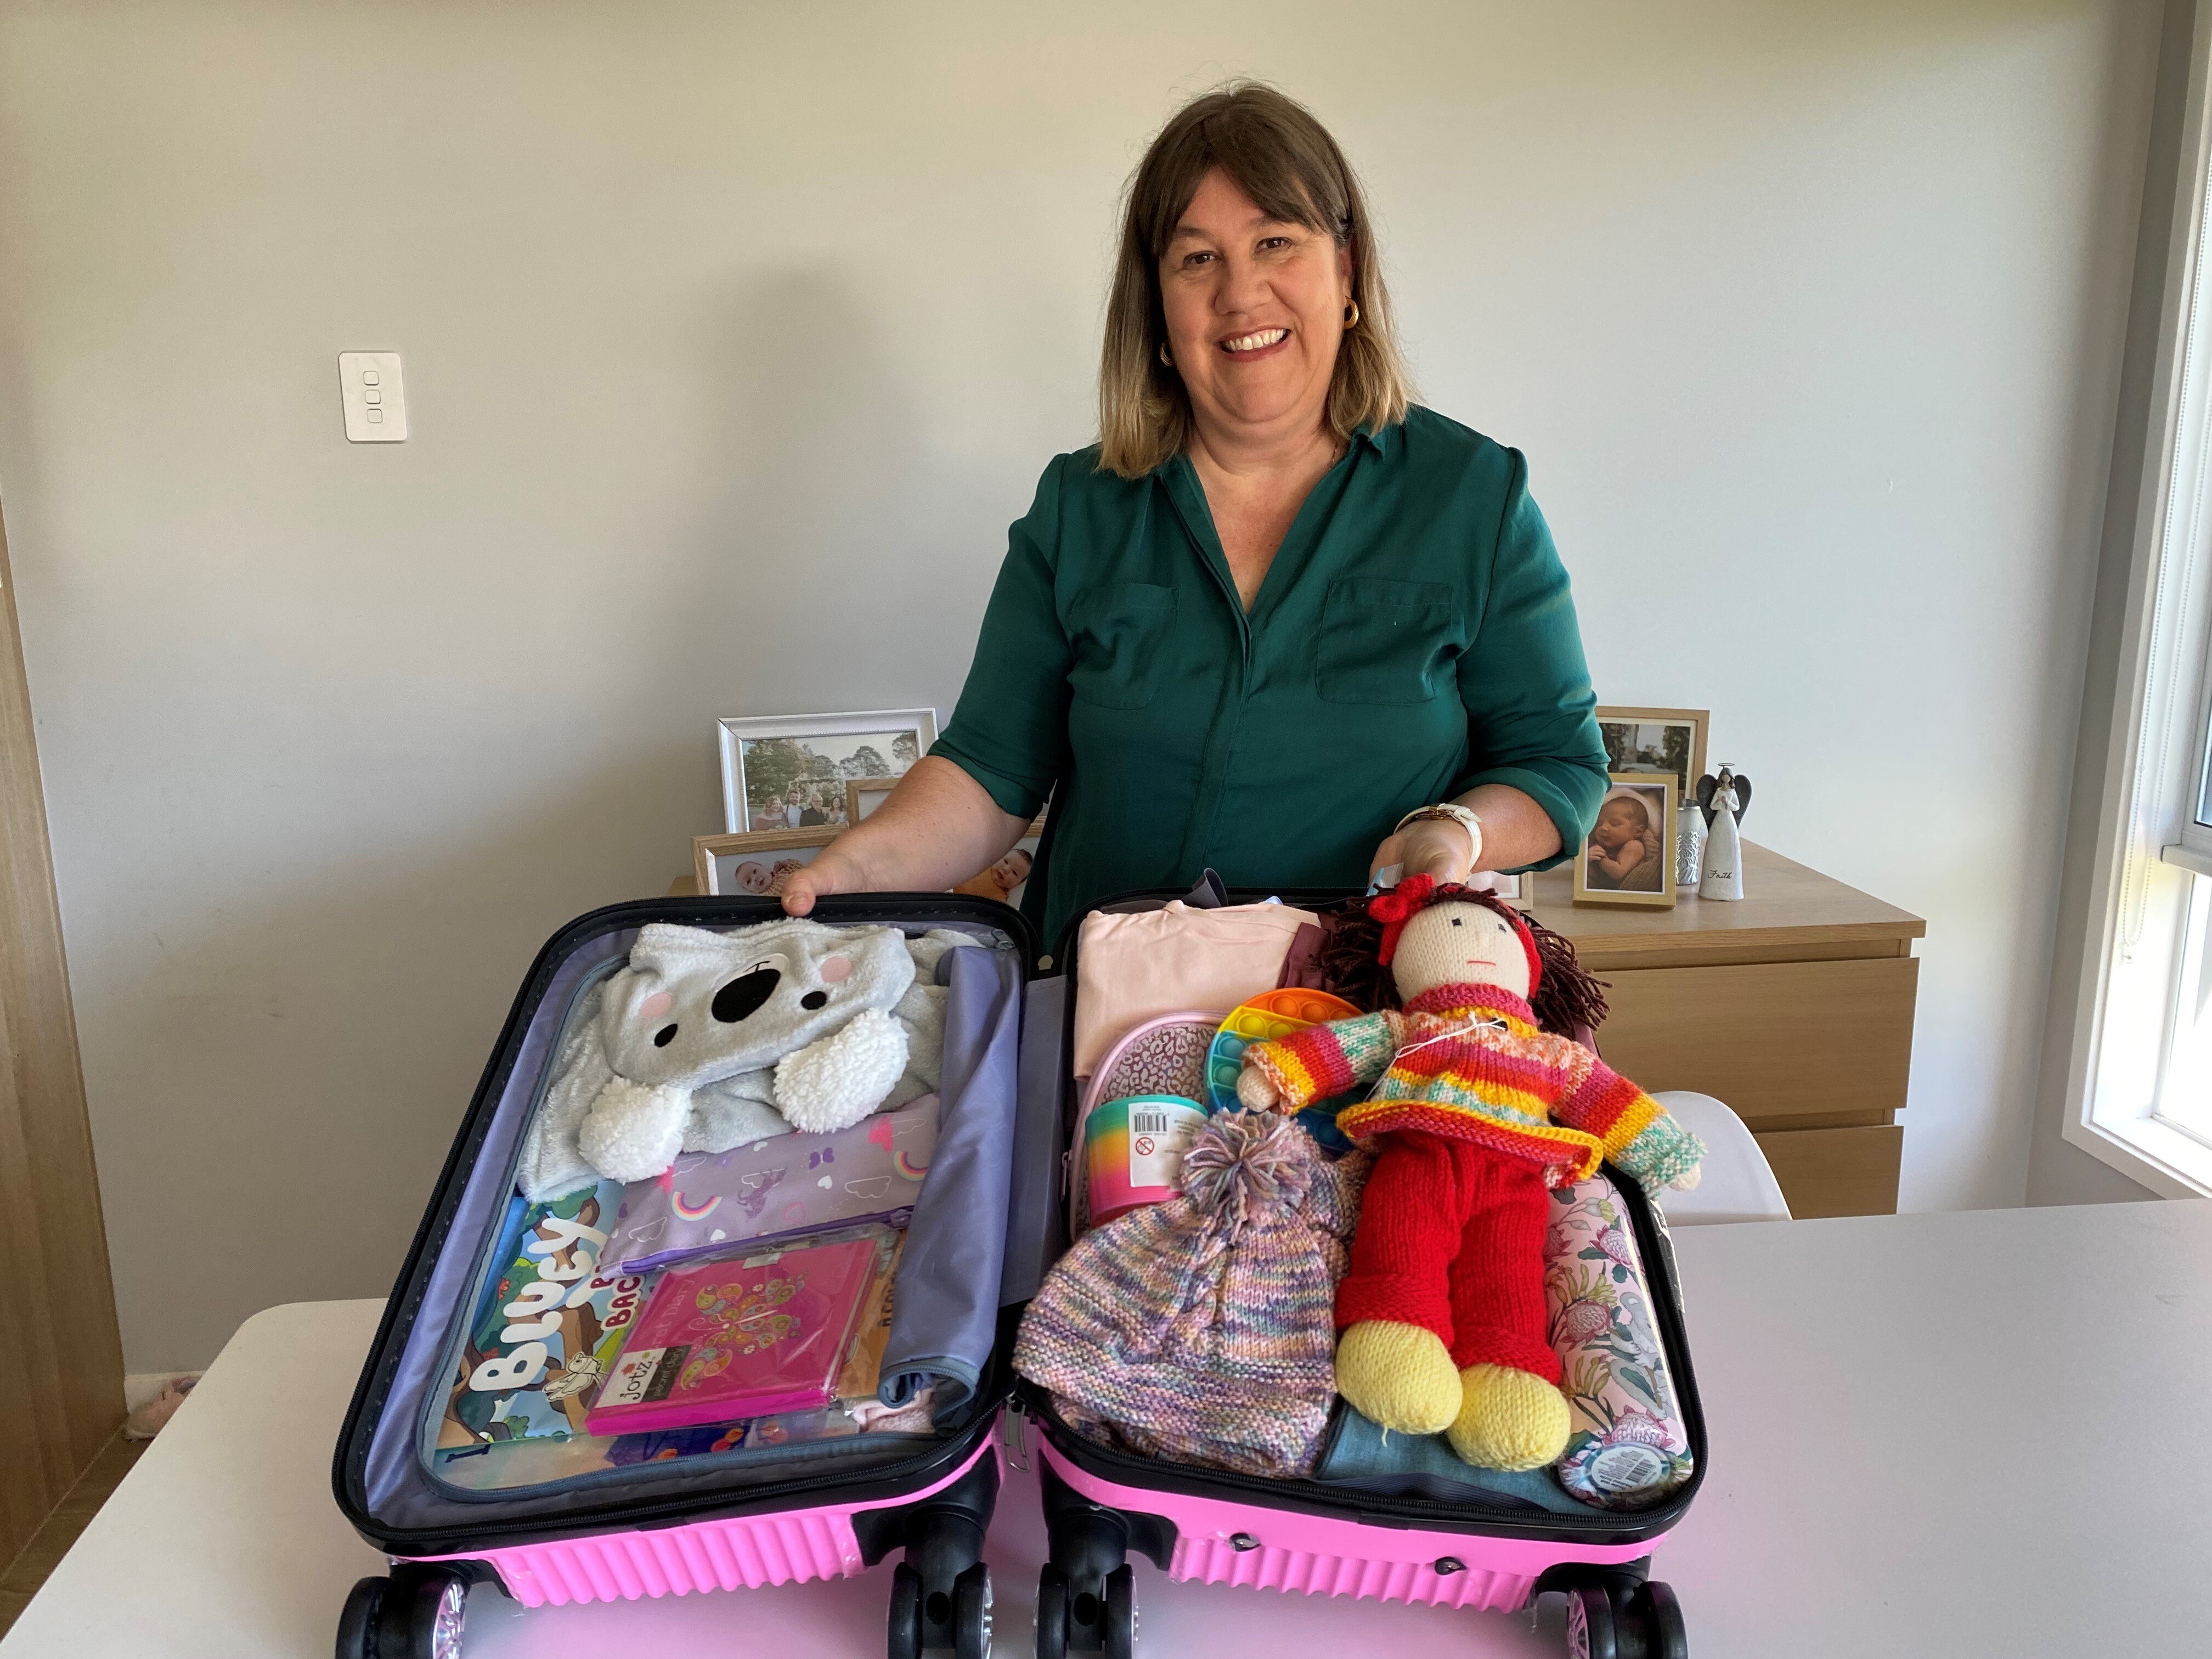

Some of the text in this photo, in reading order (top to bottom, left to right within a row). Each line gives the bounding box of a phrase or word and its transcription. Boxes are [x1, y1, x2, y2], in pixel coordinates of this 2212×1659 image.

[1707, 870, 1732, 879] Faith
[469, 1217, 608, 1391] BLUEY
[605, 1276, 641, 1328] BAC
[619, 1359, 654, 1400] jotz
